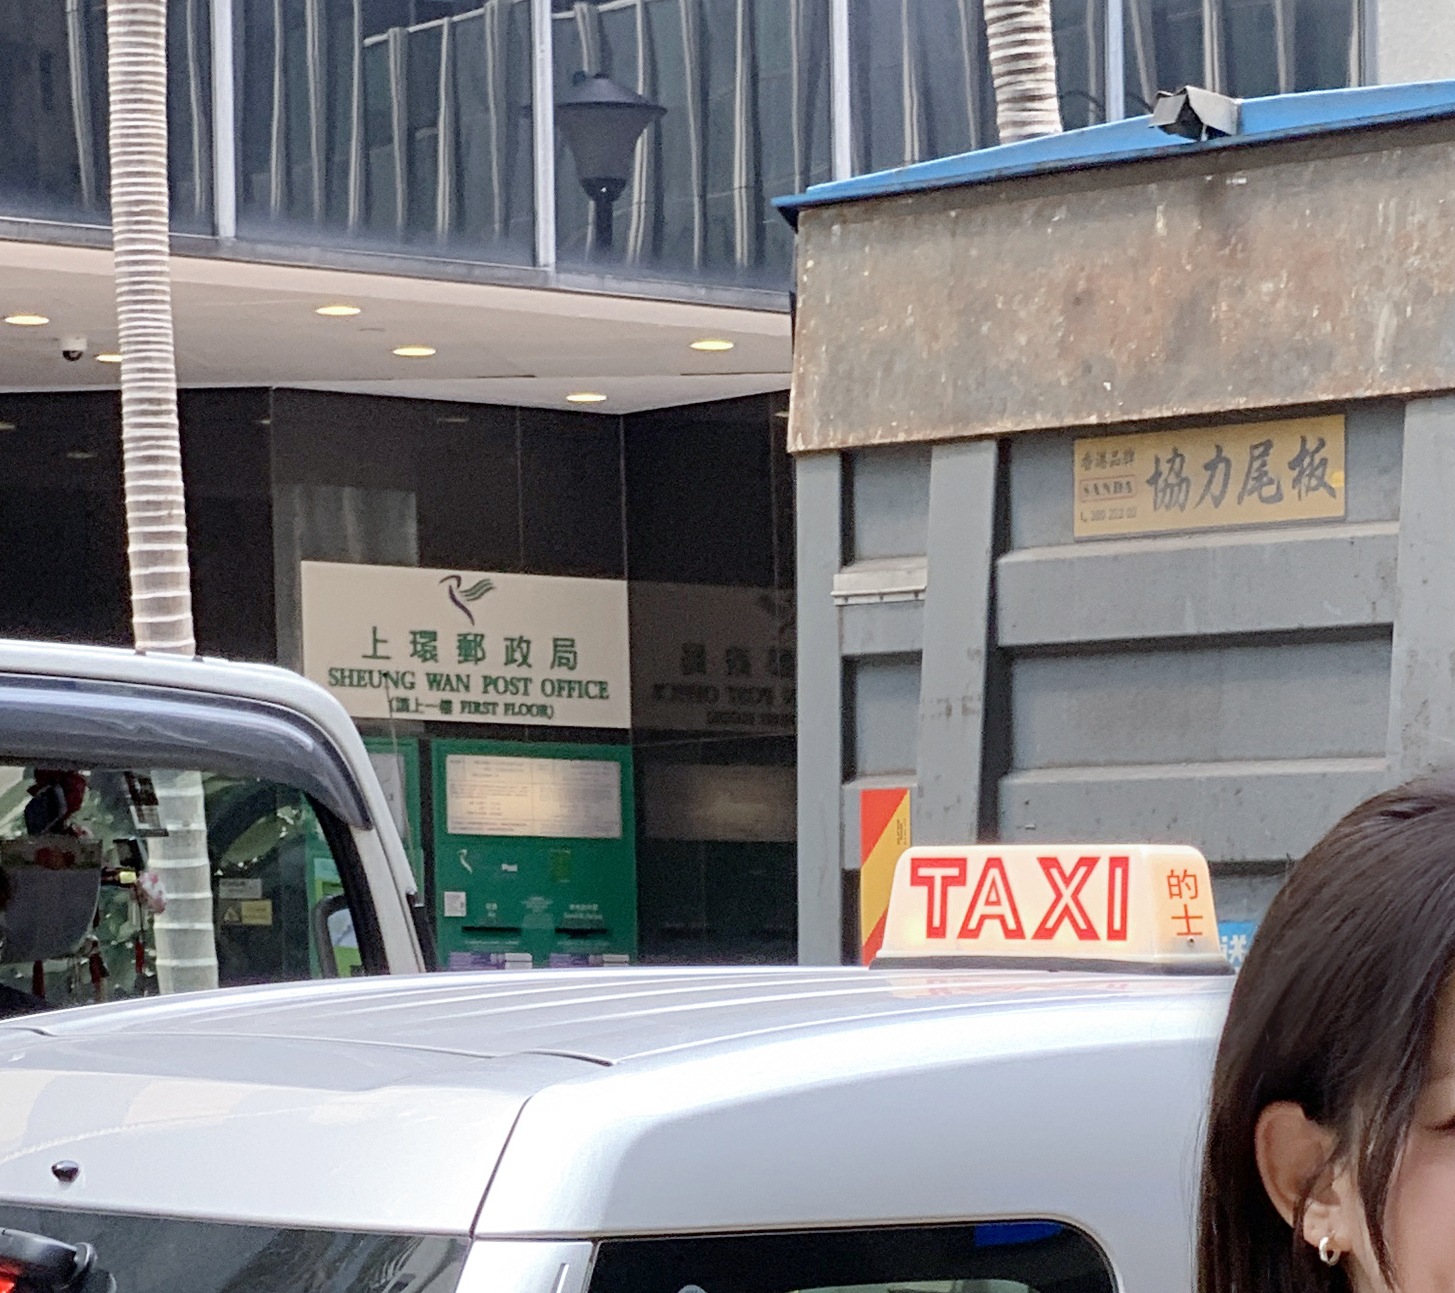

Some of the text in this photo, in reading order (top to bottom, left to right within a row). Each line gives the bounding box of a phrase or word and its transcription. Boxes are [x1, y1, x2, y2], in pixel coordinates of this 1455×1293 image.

[1146, 435, 1337, 512] 協力尾板
[361, 626, 578, 671] 上環郵政局
[327, 667, 610, 700] SHEUNG WAN POST OFFICE
[459, 699, 498, 716] FIRST
[503, 701, 555, 719] FLOOR)
[910, 856, 1130, 942] TAXI
[1166, 868, 1204, 938] 的士
